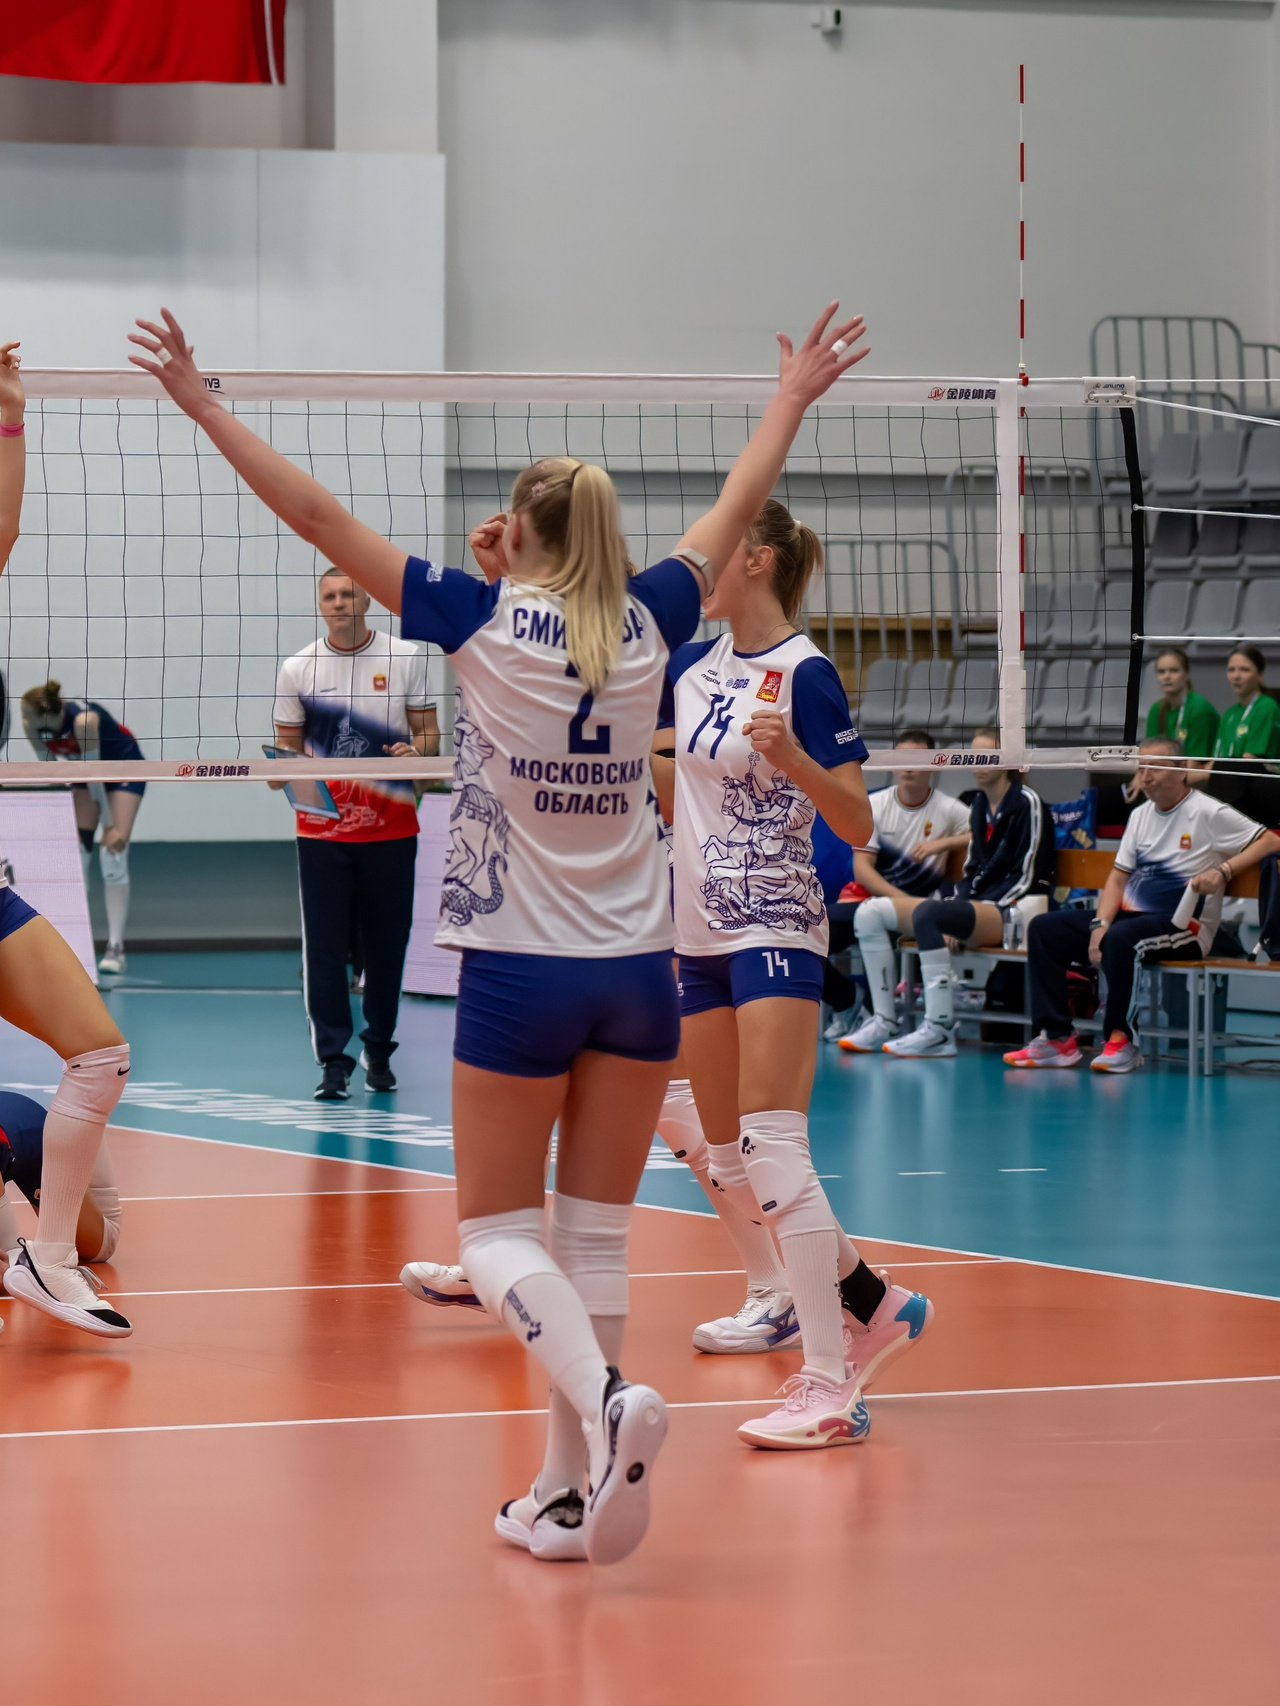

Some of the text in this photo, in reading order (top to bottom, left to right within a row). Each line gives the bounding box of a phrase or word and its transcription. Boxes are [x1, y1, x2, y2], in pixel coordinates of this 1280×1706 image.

[947, 388, 997, 400] 金陵体育
[687, 693, 736, 760] 14
[196, 765, 250, 777] 金陵体育
[510, 756, 644, 785] МОСКОВСКАЯ
[950, 755, 1000, 766] 金陵体育
[534, 790, 629, 815] ОБЛАСТЬ
[762, 951, 789, 977] 14
